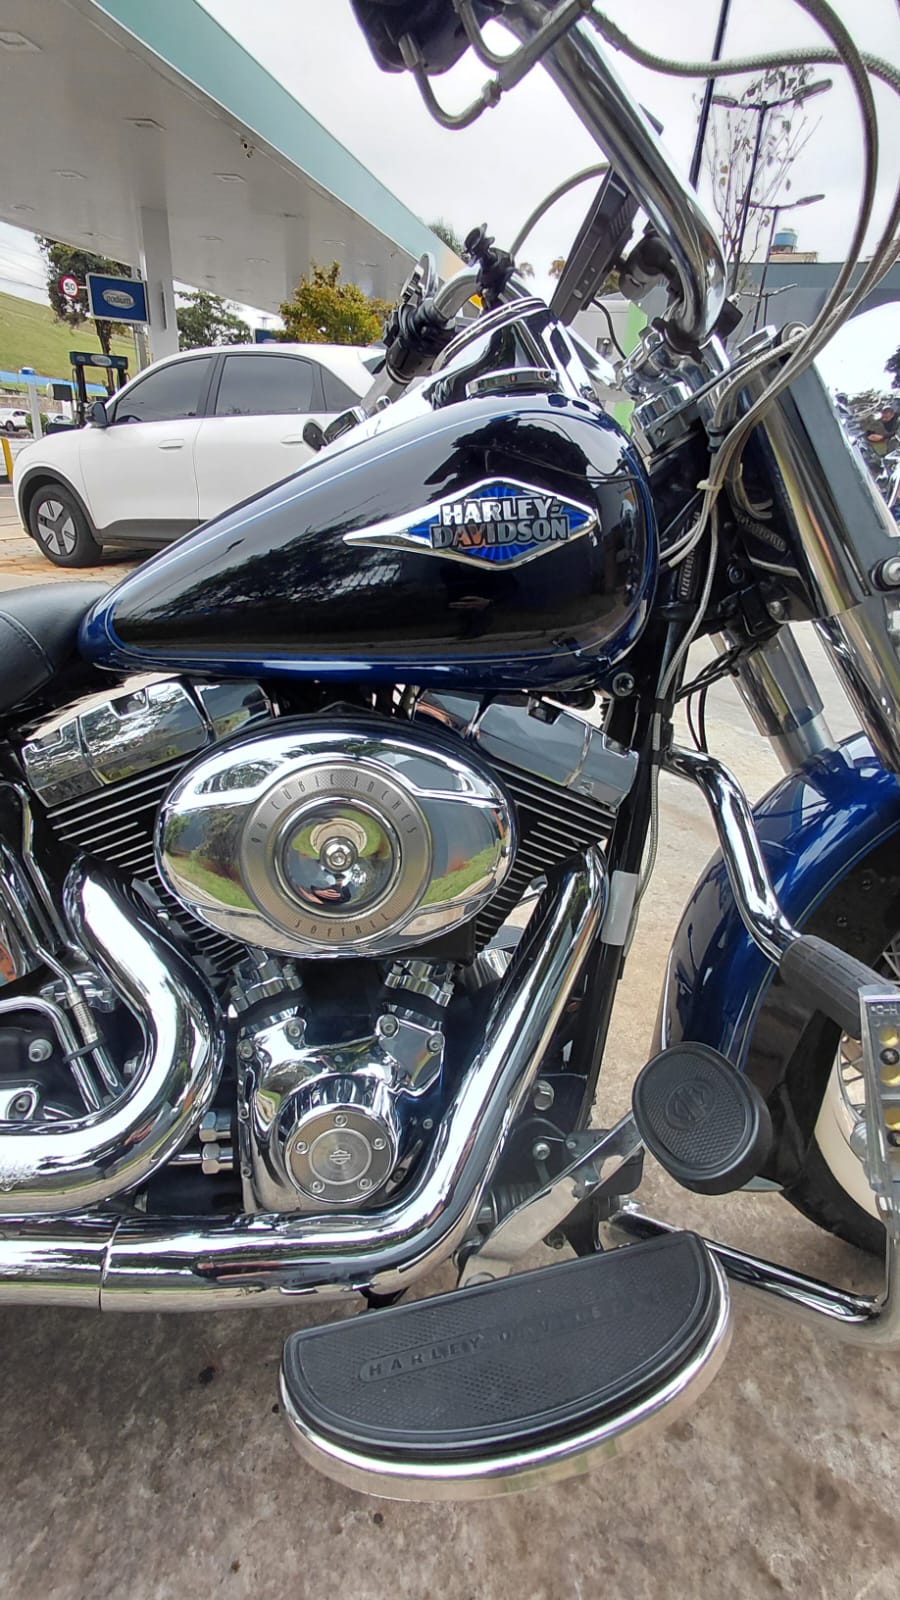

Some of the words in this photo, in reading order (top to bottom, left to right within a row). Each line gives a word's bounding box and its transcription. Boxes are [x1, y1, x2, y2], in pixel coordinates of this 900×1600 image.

[65, 281, 76, 291] 50
[441, 498, 563, 525] HARLEY-
[432, 517, 569, 548] DAVIDSON
[271, 774, 335, 811] CUBIC
[353, 775, 418, 834] INCHES
[294, 913, 392, 937] SOFTAIL
